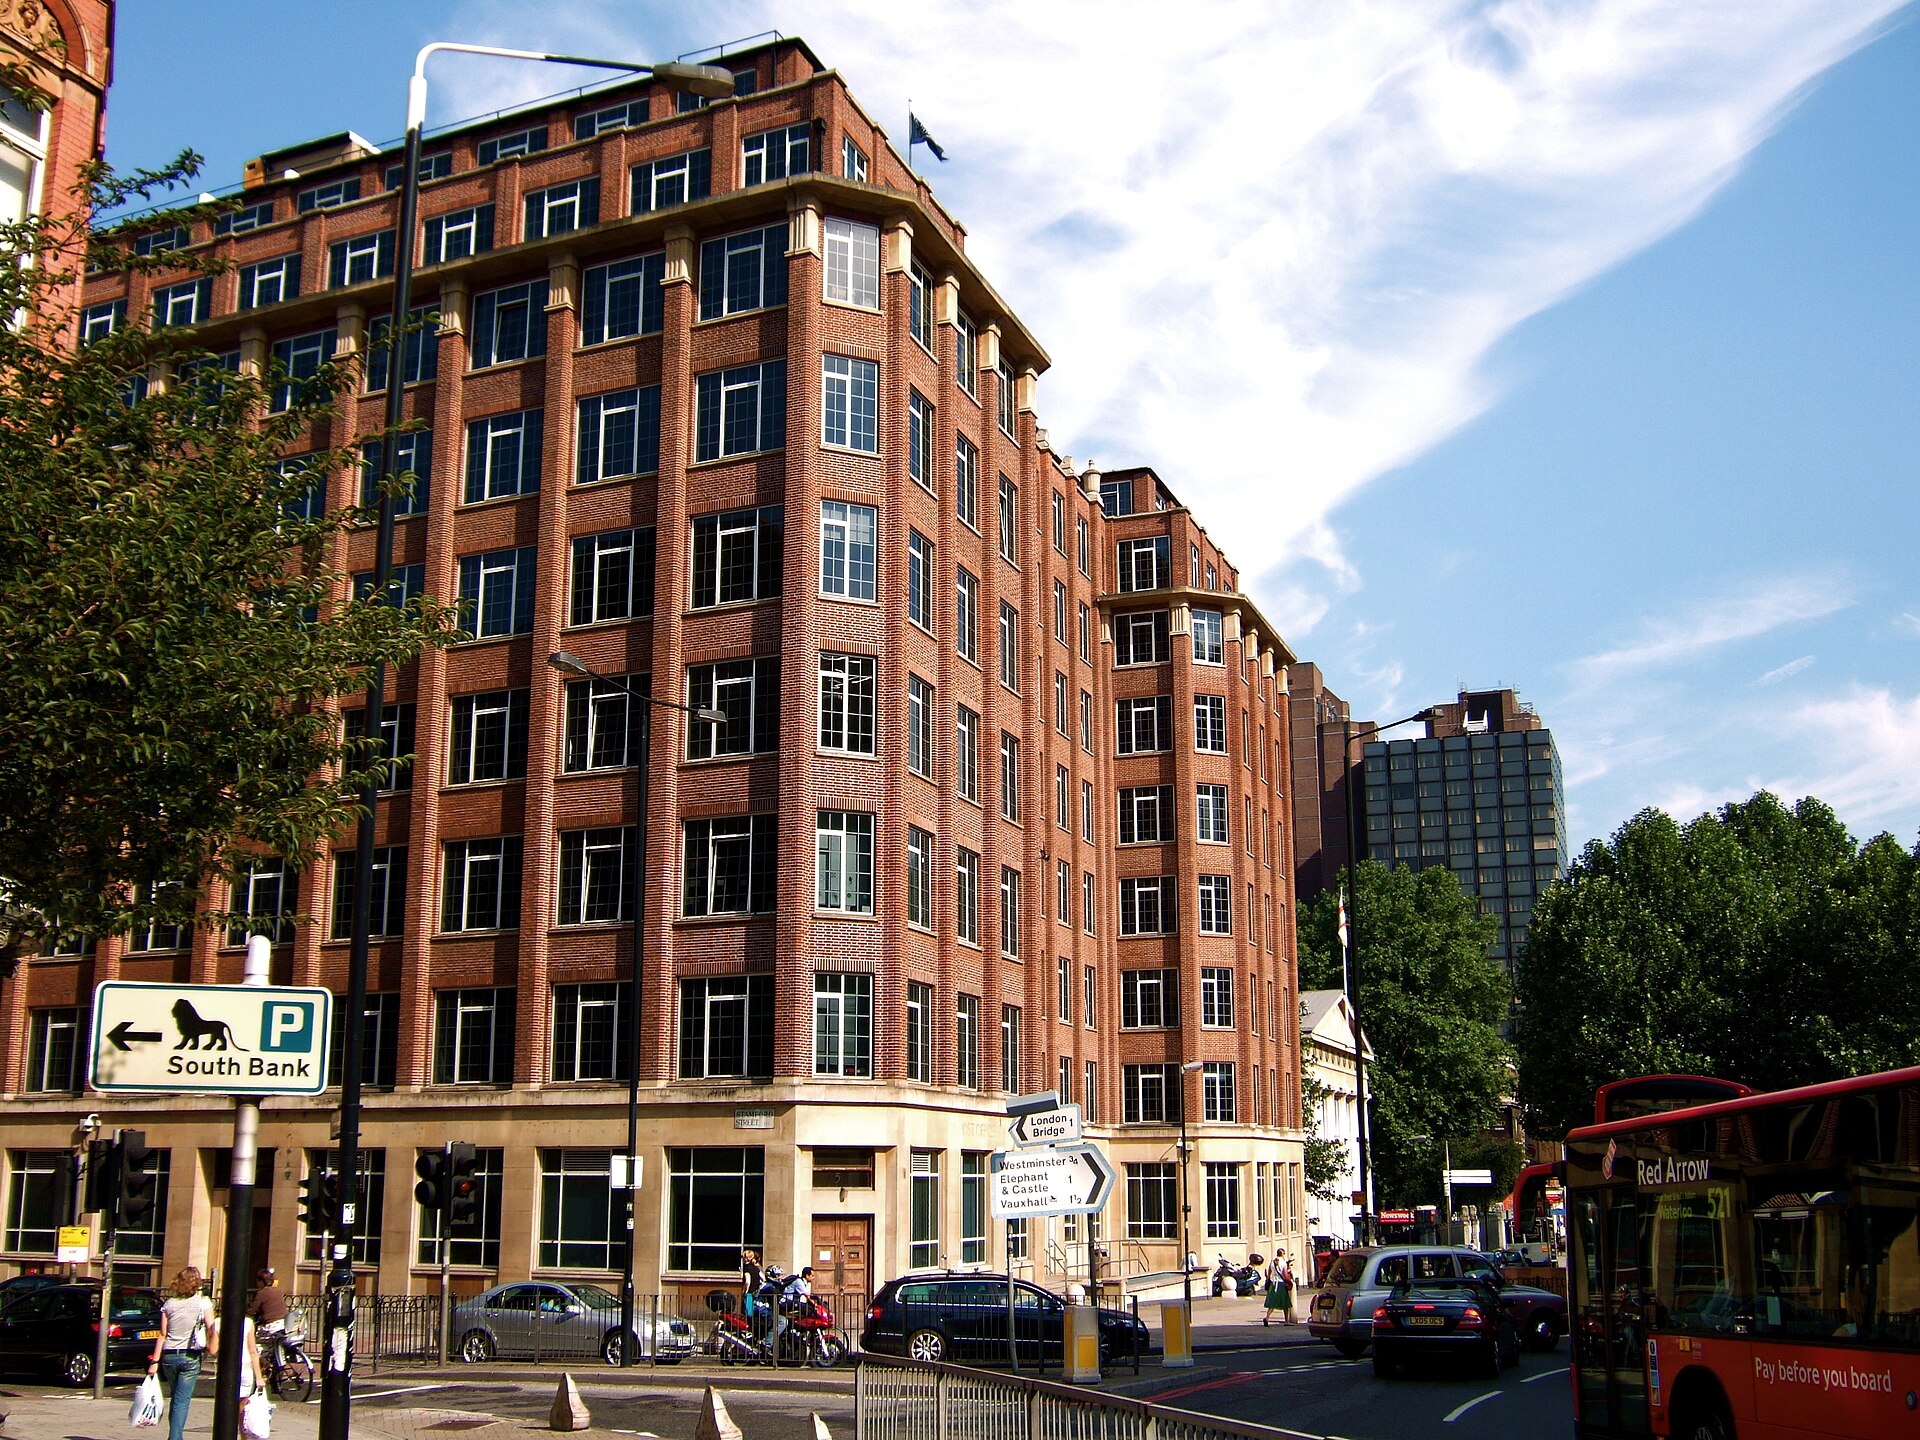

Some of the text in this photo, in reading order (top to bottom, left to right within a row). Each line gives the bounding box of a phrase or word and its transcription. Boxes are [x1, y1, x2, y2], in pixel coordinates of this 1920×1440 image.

[269, 1005, 304, 1048] P
[167, 1055, 311, 1077] South Bank
[735, 1110, 774, 1118] STAMFORD
[1030, 1114, 1074, 1127] London 1
[1033, 1126, 1065, 1138] Bridge
[999, 1158, 1067, 1171] Westminster
[1637, 1157, 1662, 1186] Red
[1665, 1156, 1709, 1183] Arrow
[1000, 1171, 1072, 1184] Elephant 1
[1001, 1184, 1049, 1196] & Castle
[1000, 1197, 1048, 1209] Vauxhall
[1707, 1187, 1731, 1219] 521
[1659, 1203, 1693, 1219] Waterloo
[1755, 1357, 1892, 1393] Pay before you board
